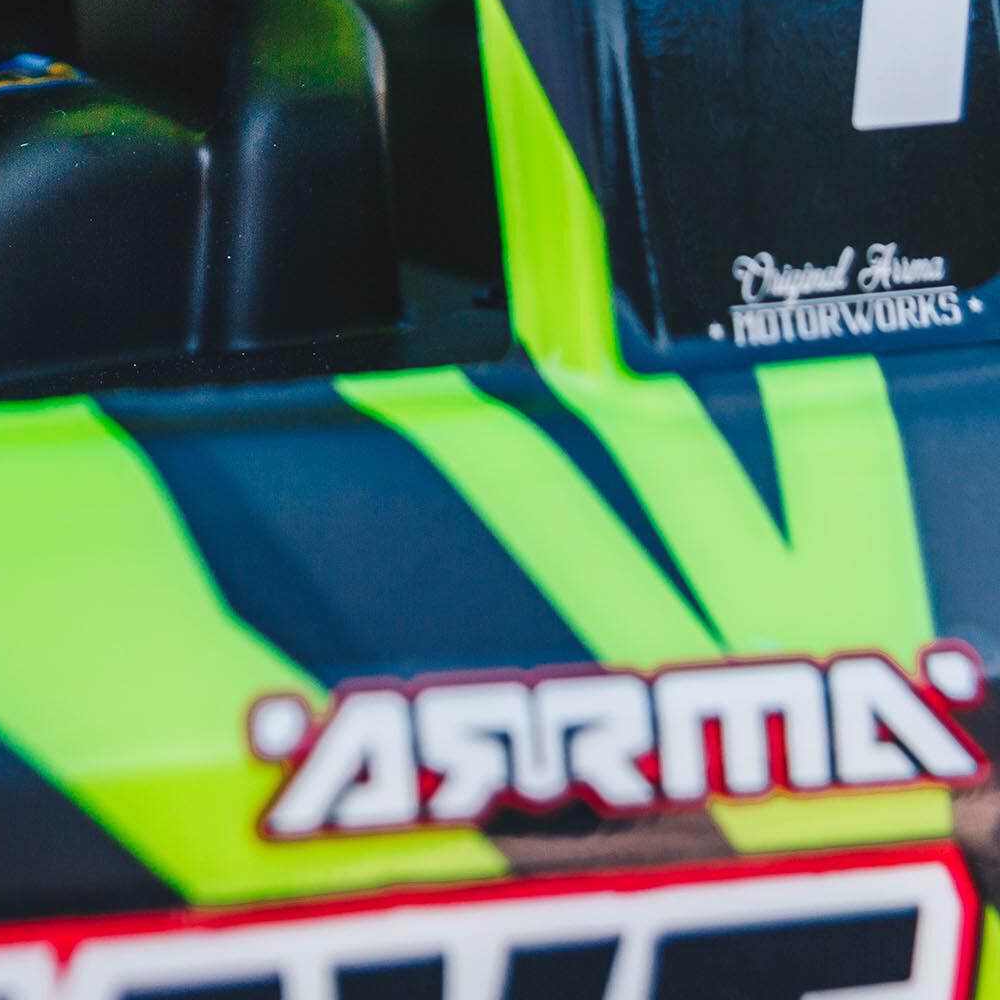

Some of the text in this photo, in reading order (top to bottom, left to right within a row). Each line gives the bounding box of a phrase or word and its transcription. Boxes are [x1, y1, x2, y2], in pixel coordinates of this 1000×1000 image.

[732, 246, 856, 305] Original
[731, 291, 963, 348] MOTORWORKS
[260, 650, 984, 838] ARRMA
